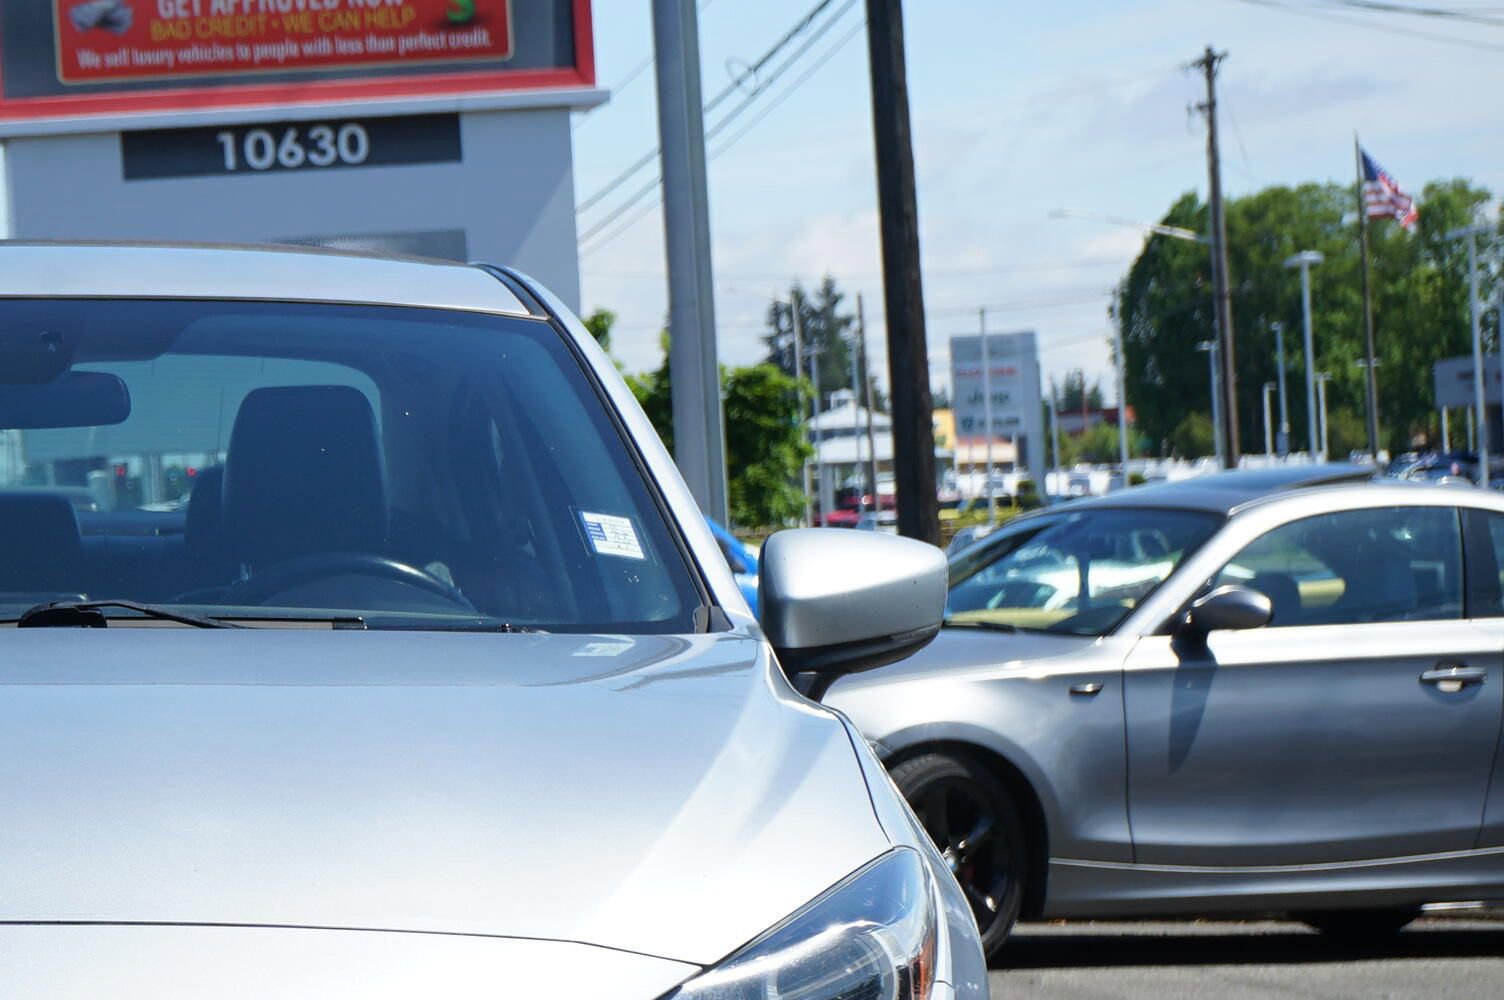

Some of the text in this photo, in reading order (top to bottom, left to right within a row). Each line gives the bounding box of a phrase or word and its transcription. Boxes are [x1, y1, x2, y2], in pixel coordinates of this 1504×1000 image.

[151, 5, 416, 40] BAD CREDIT WE CAN HELP
[76, 48, 101, 69] We
[177, 43, 233, 63] vehicles
[302, 36, 332, 56] with
[397, 29, 445, 56] perfect
[216, 123, 369, 170] 10630
